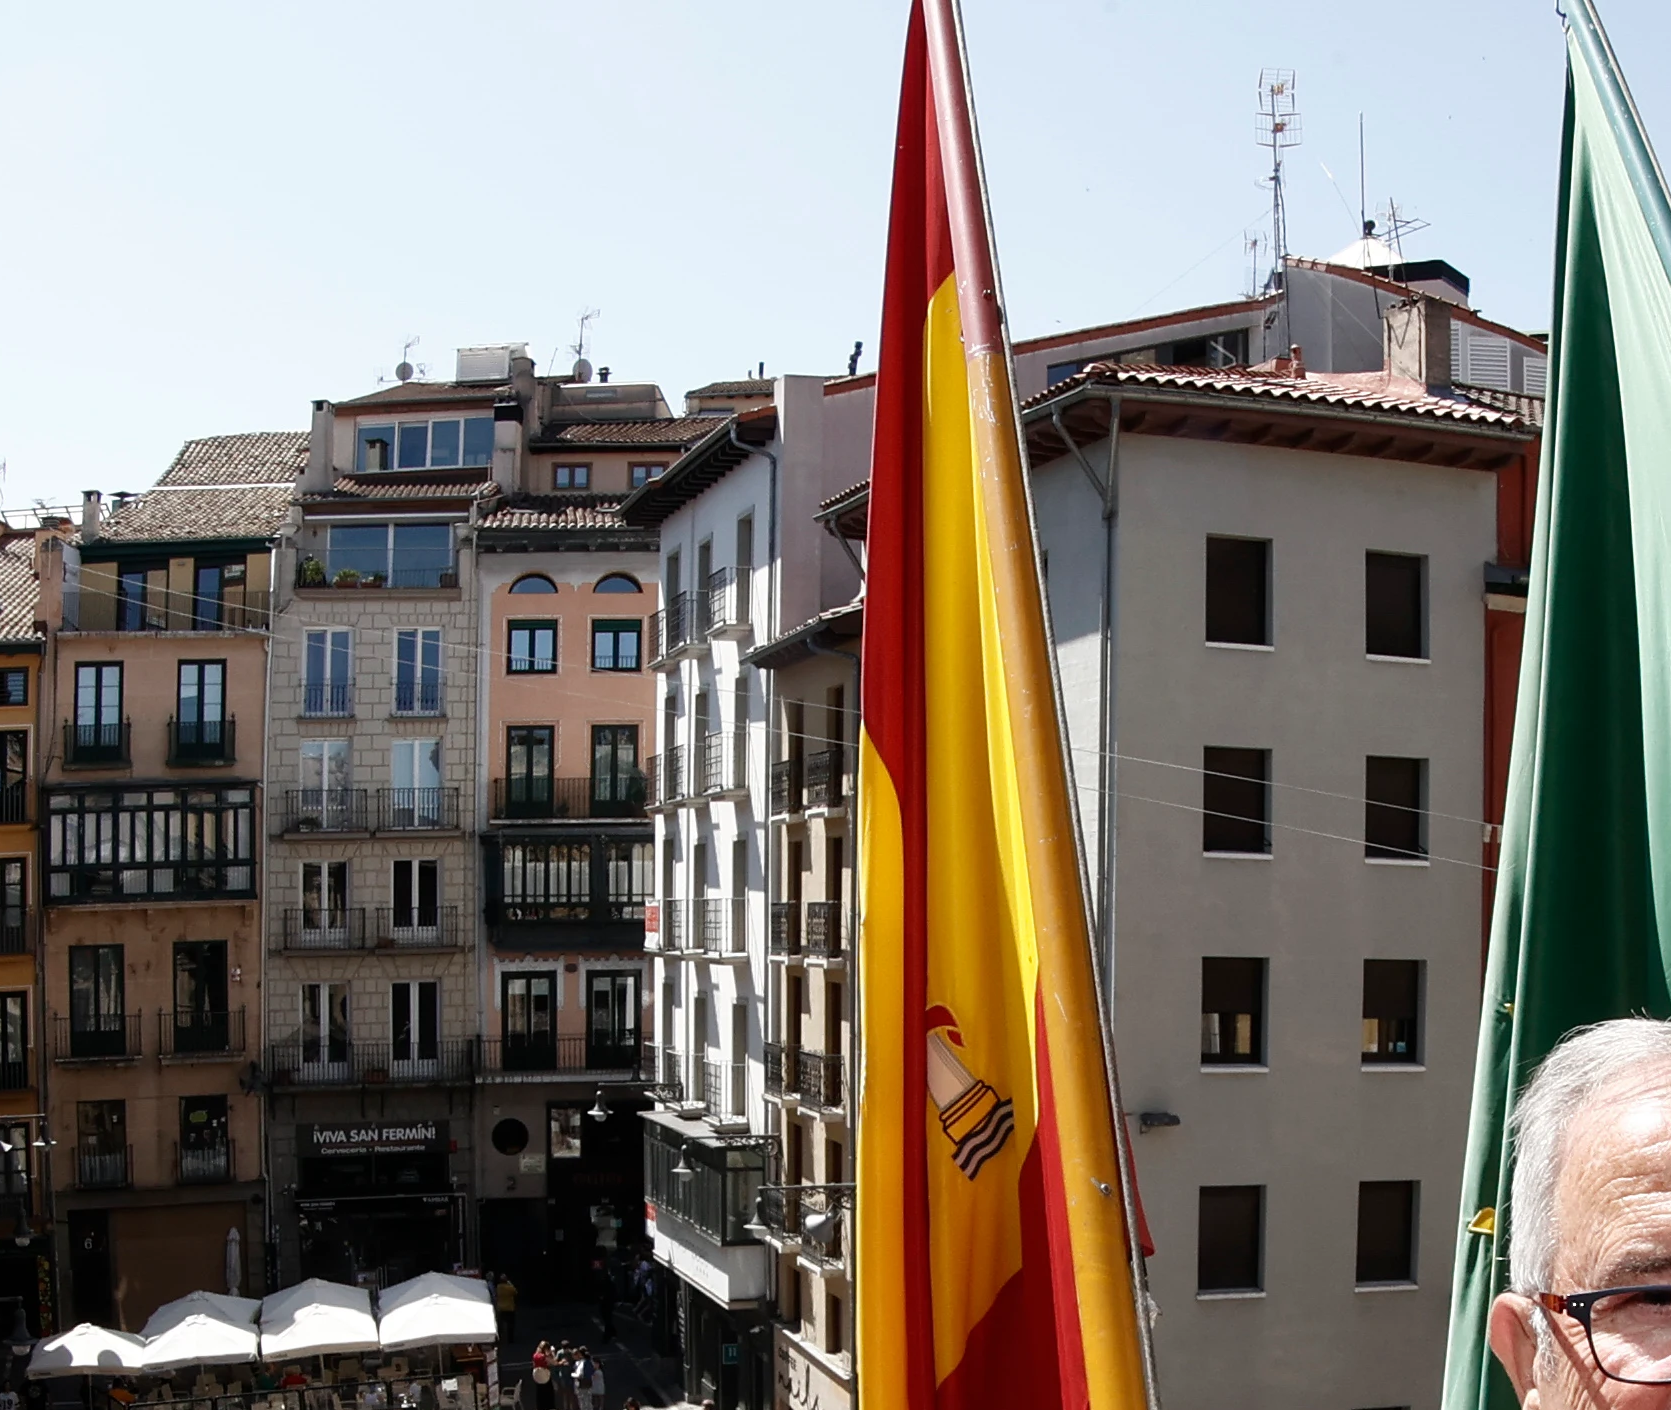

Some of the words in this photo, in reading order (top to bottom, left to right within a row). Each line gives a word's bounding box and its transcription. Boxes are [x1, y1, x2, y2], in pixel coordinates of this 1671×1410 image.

[350, 1128, 378, 1142] SAN
[382, 1122, 436, 1141] FERMÍN!
[84, 1237, 93, 1250] 6
